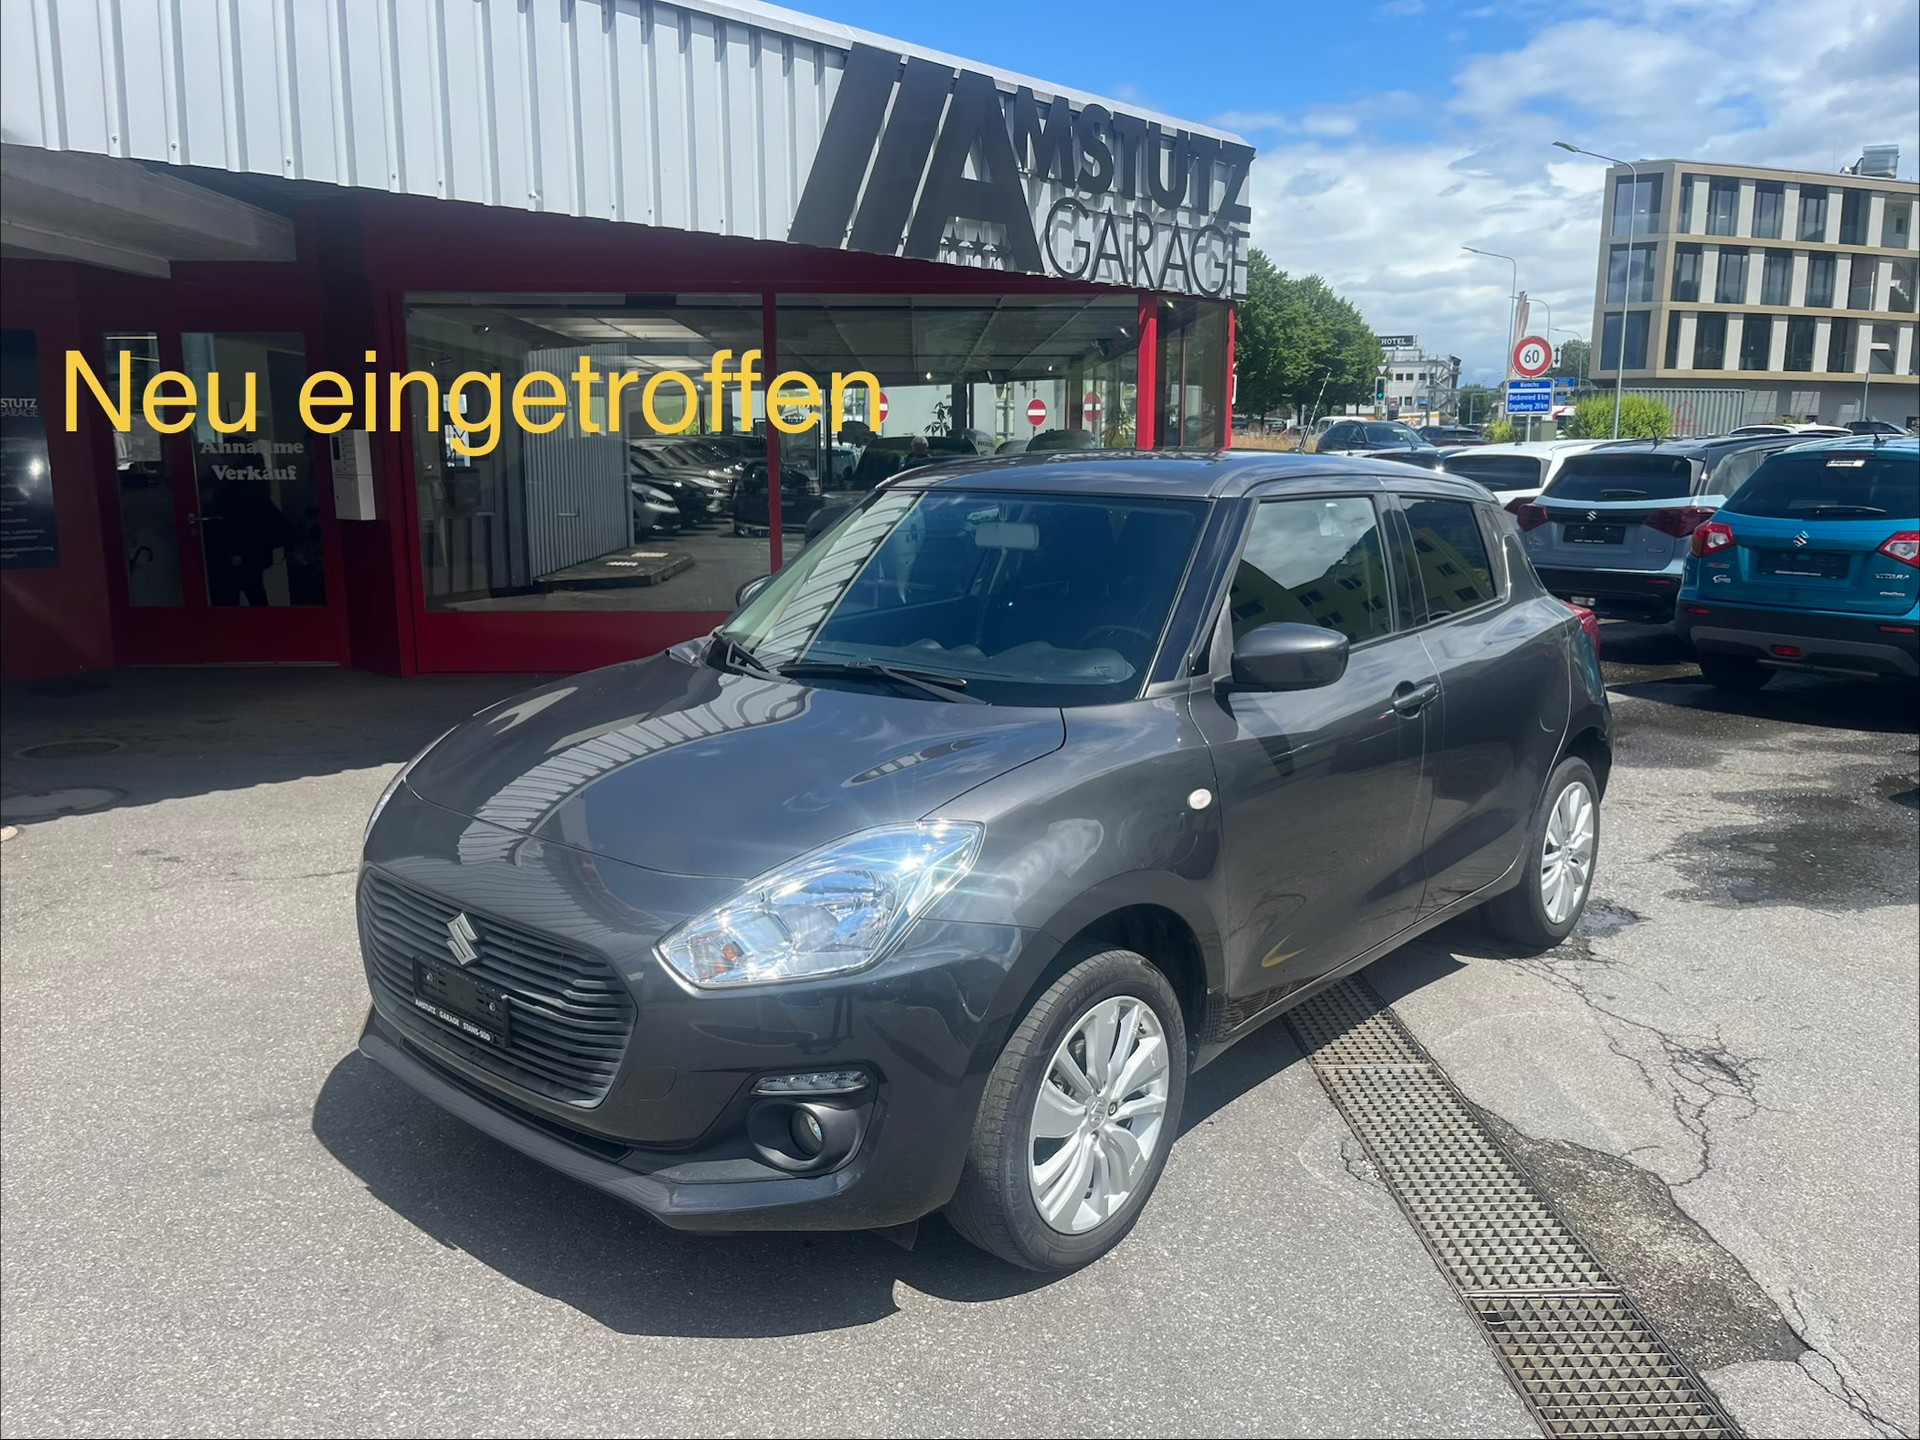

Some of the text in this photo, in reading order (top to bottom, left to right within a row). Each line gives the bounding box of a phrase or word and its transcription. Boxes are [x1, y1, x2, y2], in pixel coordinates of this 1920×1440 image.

[1045, 197, 1250, 301] GARAGE
[1381, 337, 1406, 345] HOTEL
[1524, 350, 1540, 363] 60
[200, 439, 304, 454] Anname
[211, 465, 297, 480] Verkauf
[415, 998, 436, 1015] AMSTUTZ
[439, 1010, 459, 1026] GARAGE
